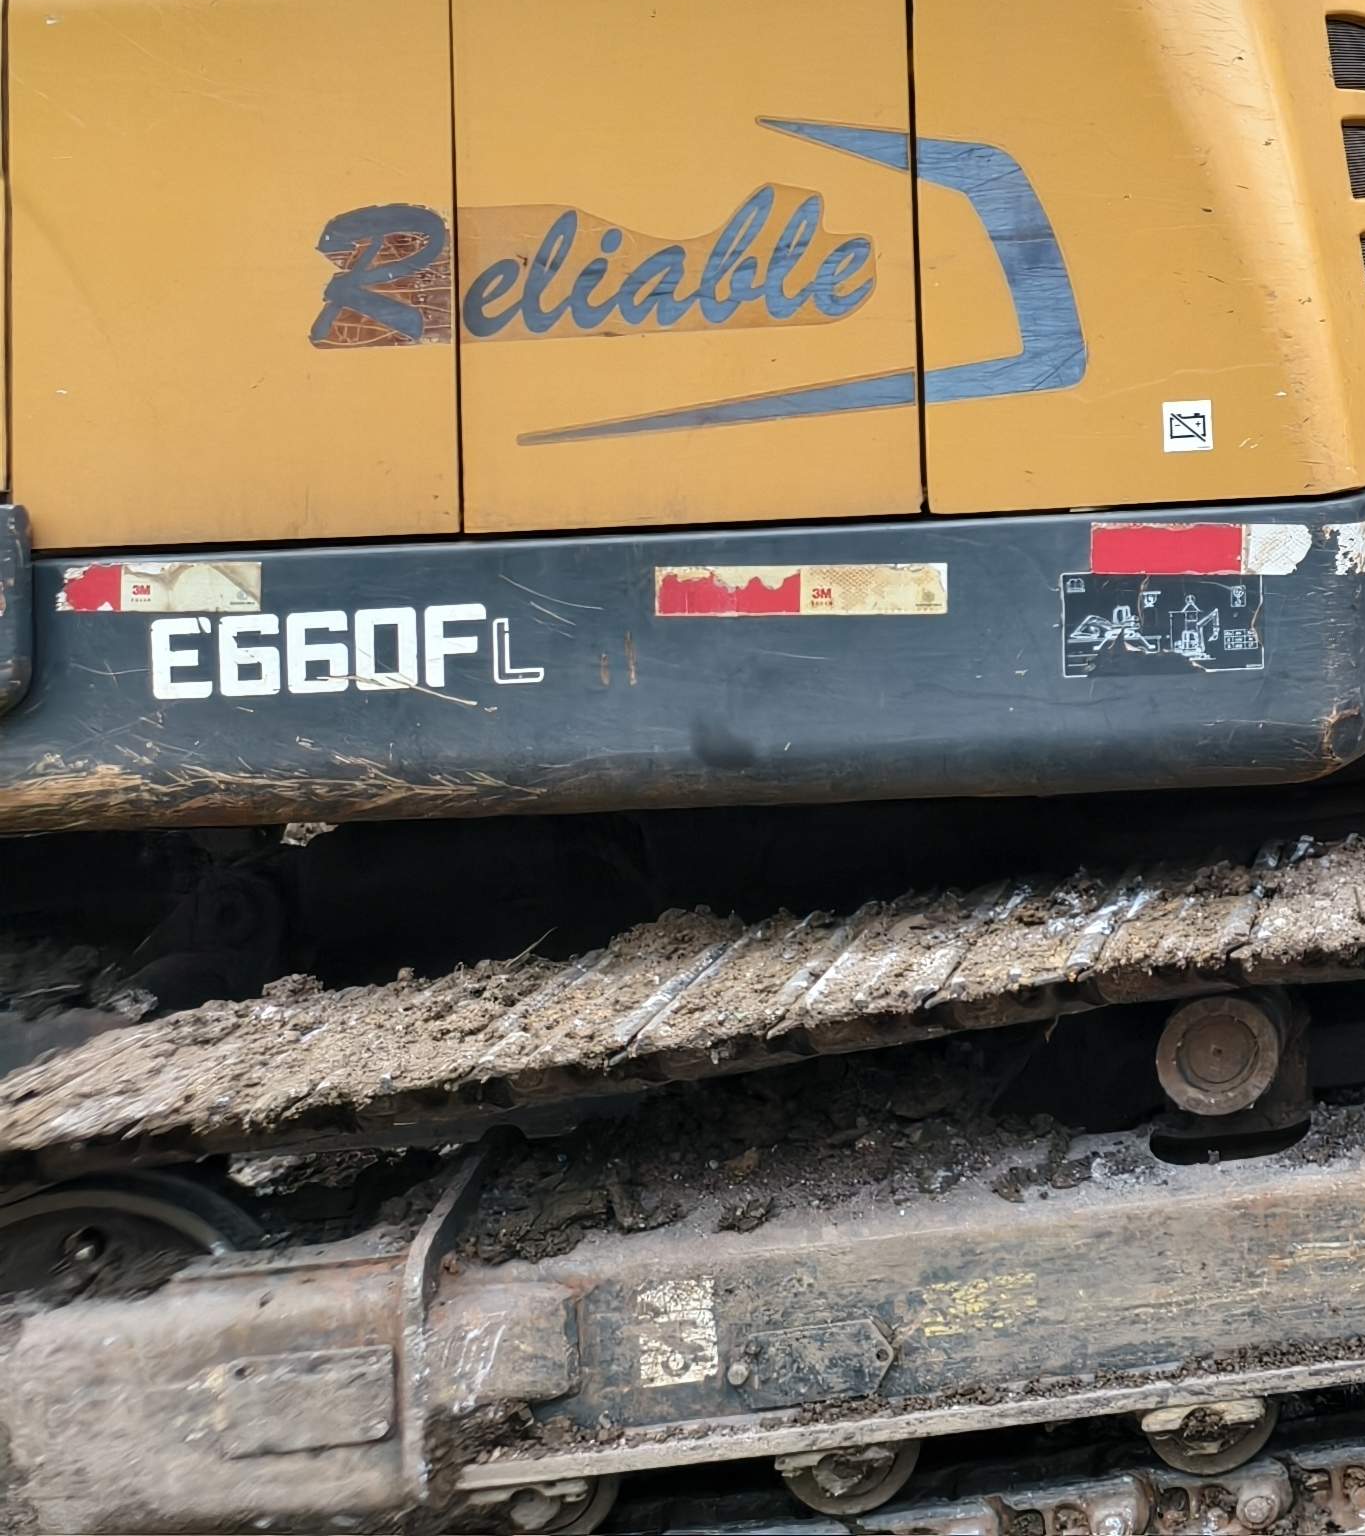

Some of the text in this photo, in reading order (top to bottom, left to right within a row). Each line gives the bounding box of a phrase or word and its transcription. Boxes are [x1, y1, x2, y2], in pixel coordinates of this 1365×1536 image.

[310, 184, 874, 344] Reliable
[132, 584, 151, 596] 3M
[811, 587, 832, 600] 3M
